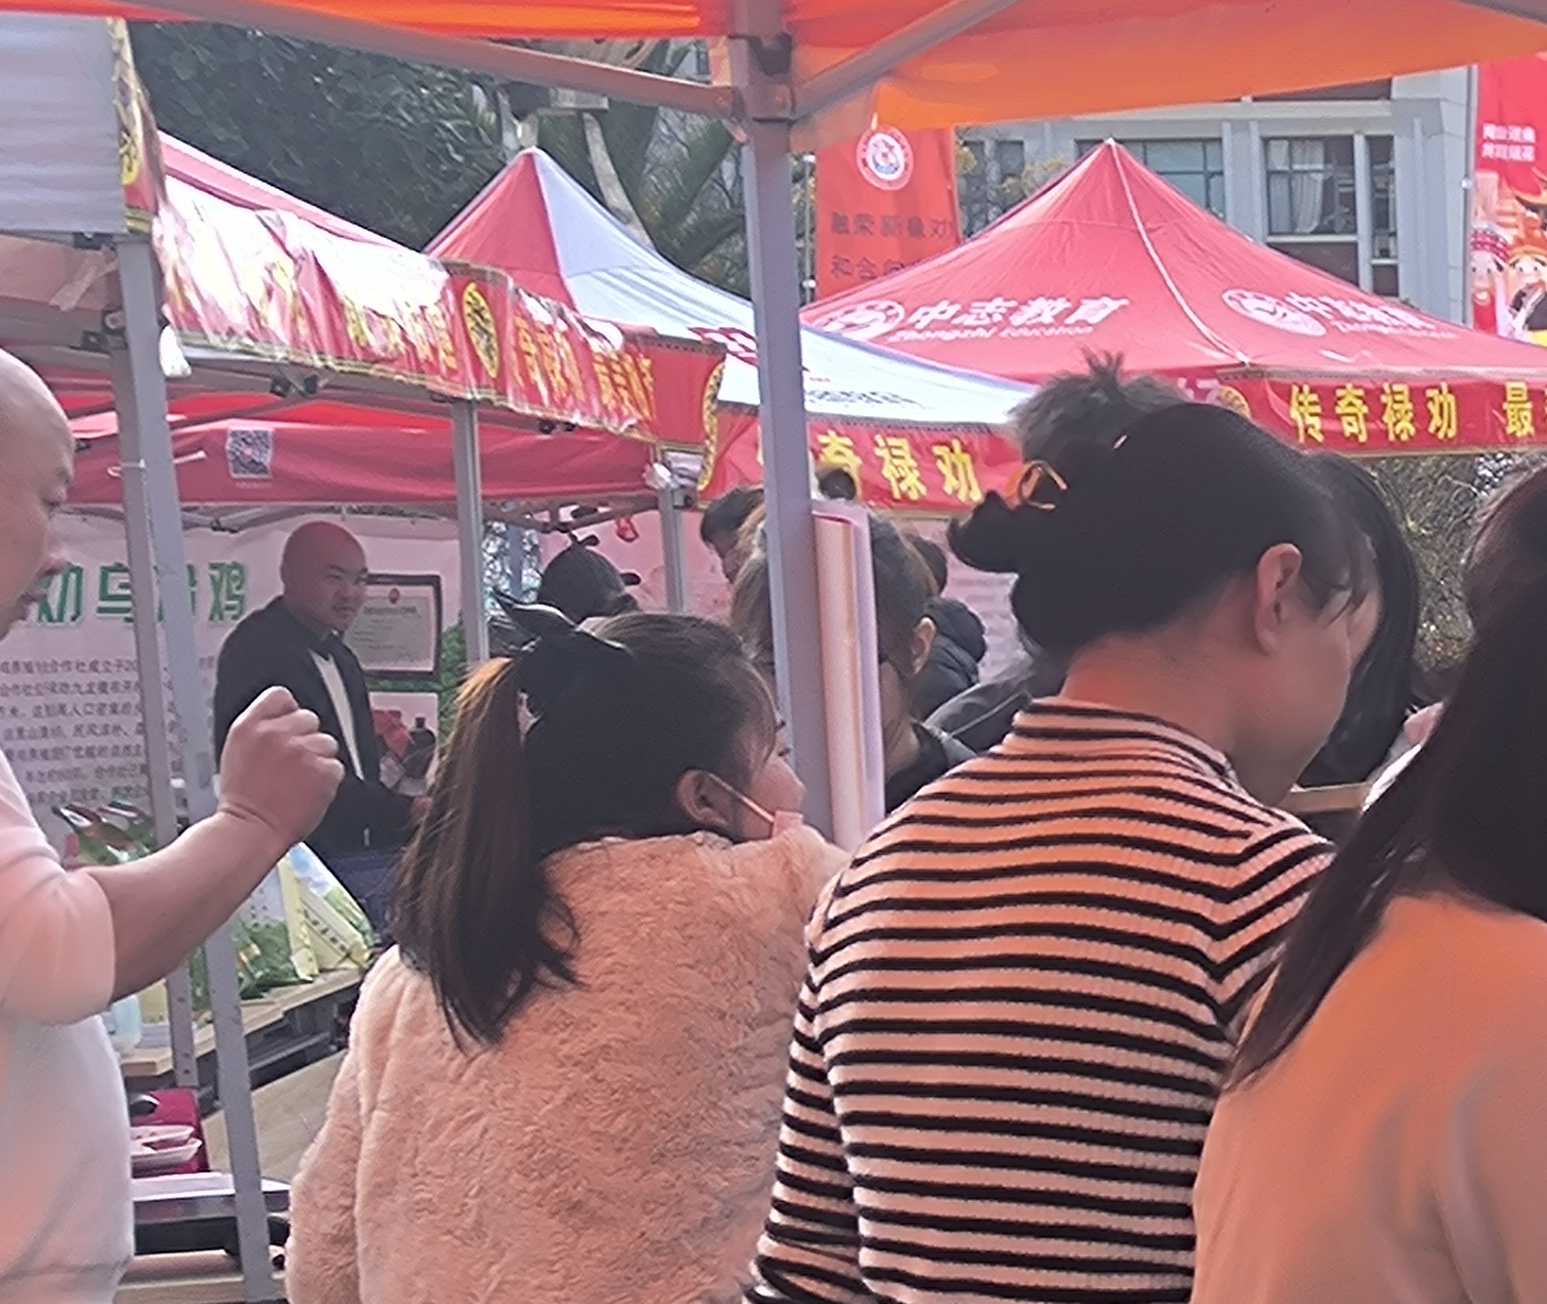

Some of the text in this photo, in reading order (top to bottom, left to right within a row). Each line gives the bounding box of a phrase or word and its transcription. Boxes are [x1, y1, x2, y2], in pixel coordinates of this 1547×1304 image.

[908, 296, 1128, 330] 中志教育
[1290, 381, 1458, 442] 传奇禄劝
[756, 428, 985, 502] 奇禄劝
[38, 562, 246, 622] 劝乌鸡
